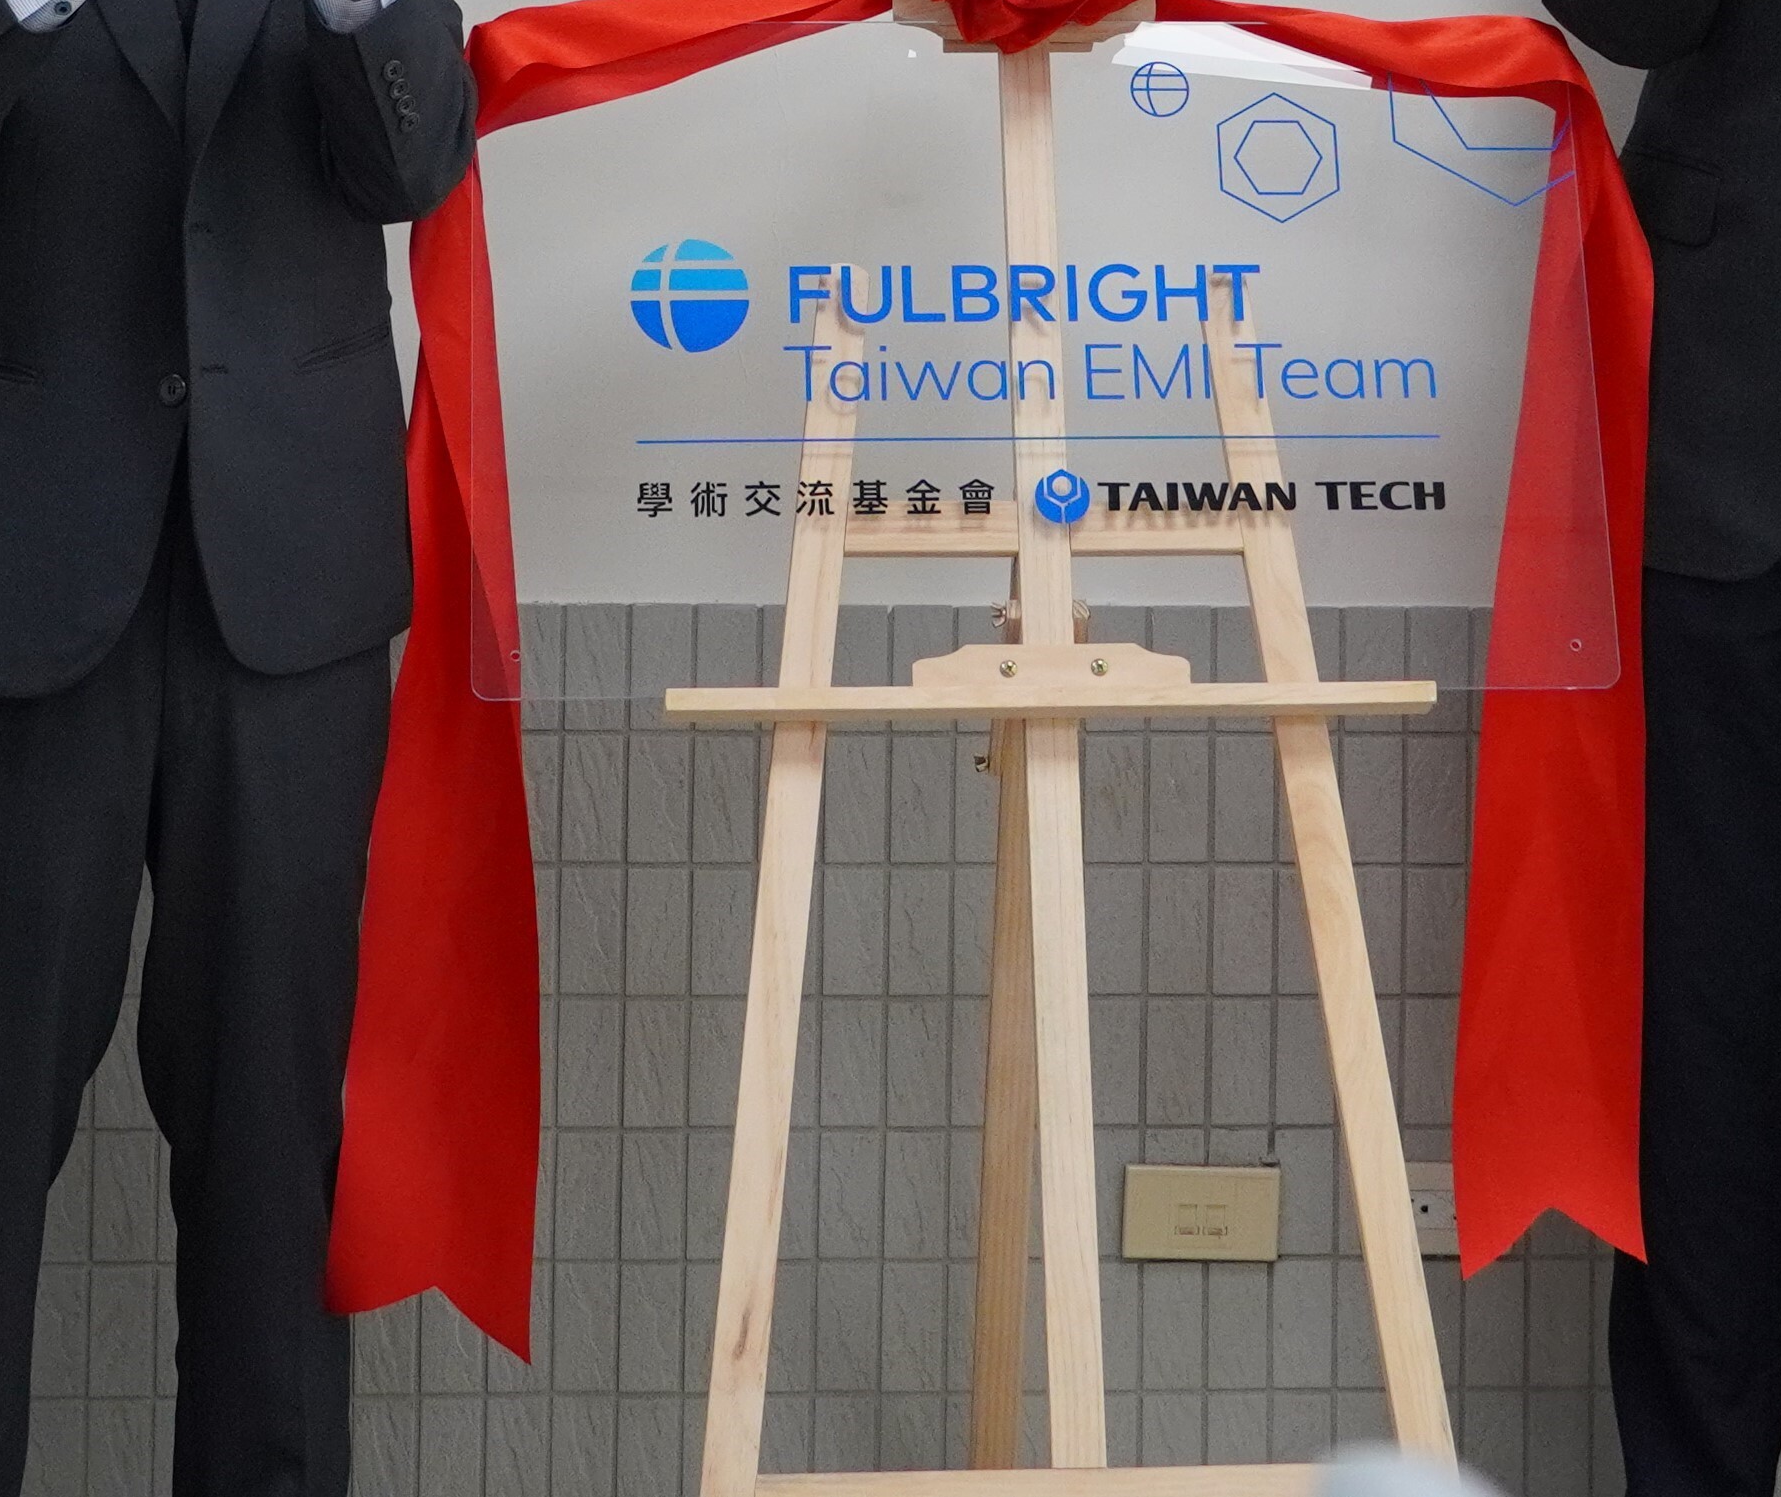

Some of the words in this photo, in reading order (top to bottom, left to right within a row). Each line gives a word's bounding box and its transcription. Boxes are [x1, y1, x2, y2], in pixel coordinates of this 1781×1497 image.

[788, 263, 1260, 324] FULBRIGHT
[783, 345, 1056, 401] Taiwan
[1084, 343, 1211, 400] EMI
[1233, 343, 1437, 400] Team
[636, 478, 996, 519] 學術交流基金會
[1097, 482, 1298, 512] TAIWAN
[1315, 481, 1447, 511] TECH
